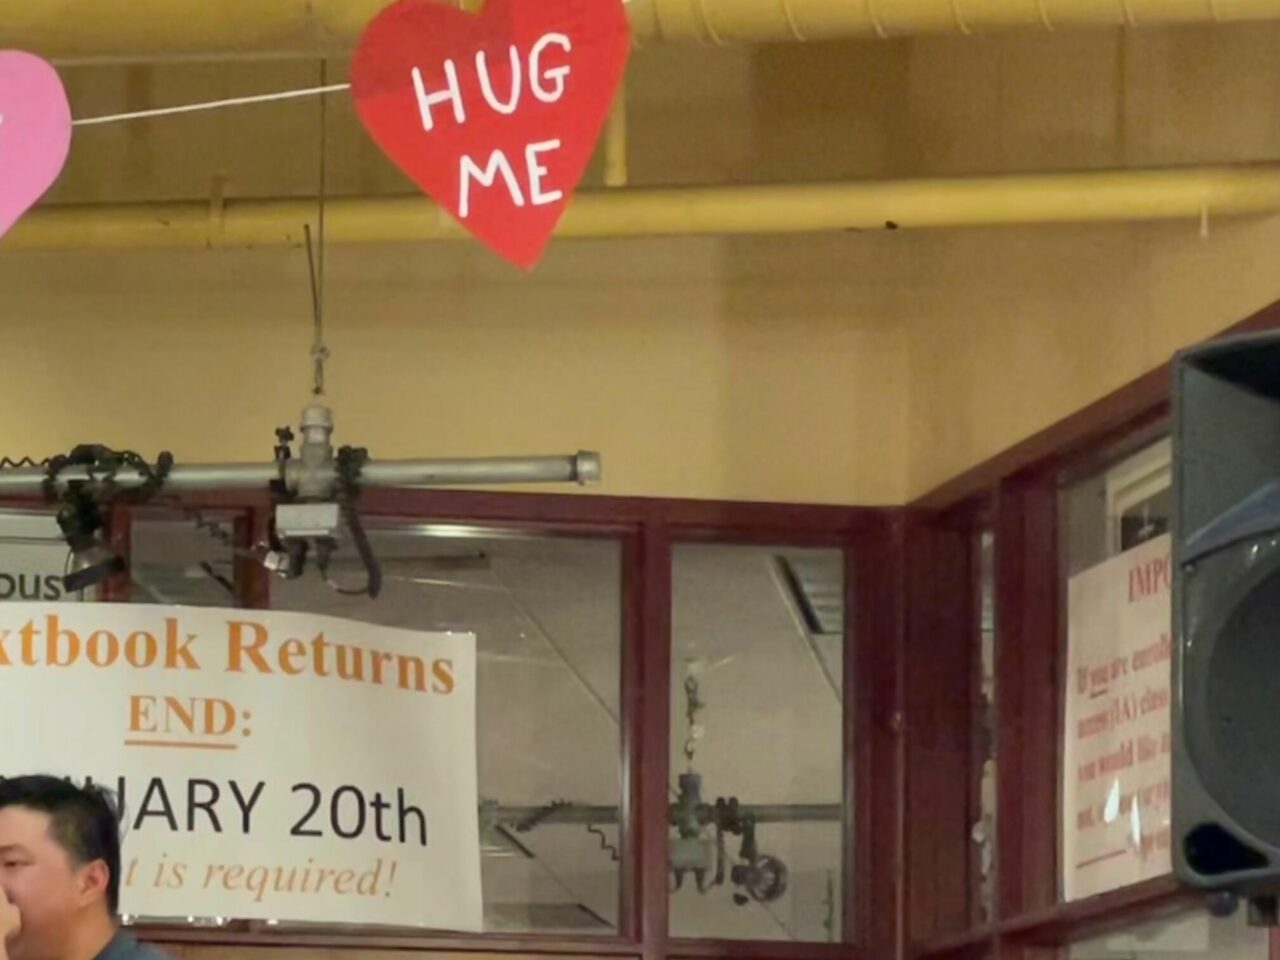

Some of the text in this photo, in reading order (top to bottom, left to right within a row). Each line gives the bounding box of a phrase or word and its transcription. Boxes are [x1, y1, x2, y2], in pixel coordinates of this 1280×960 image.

[411, 32, 571, 131] HUG
[459, 138, 562, 218] ME
[225, 620, 455, 695] Returns
[126, 695, 253, 736] END:
[290, 784, 428, 846] 20th
[153, 852, 187, 888] is
[203, 856, 397, 902] required!
